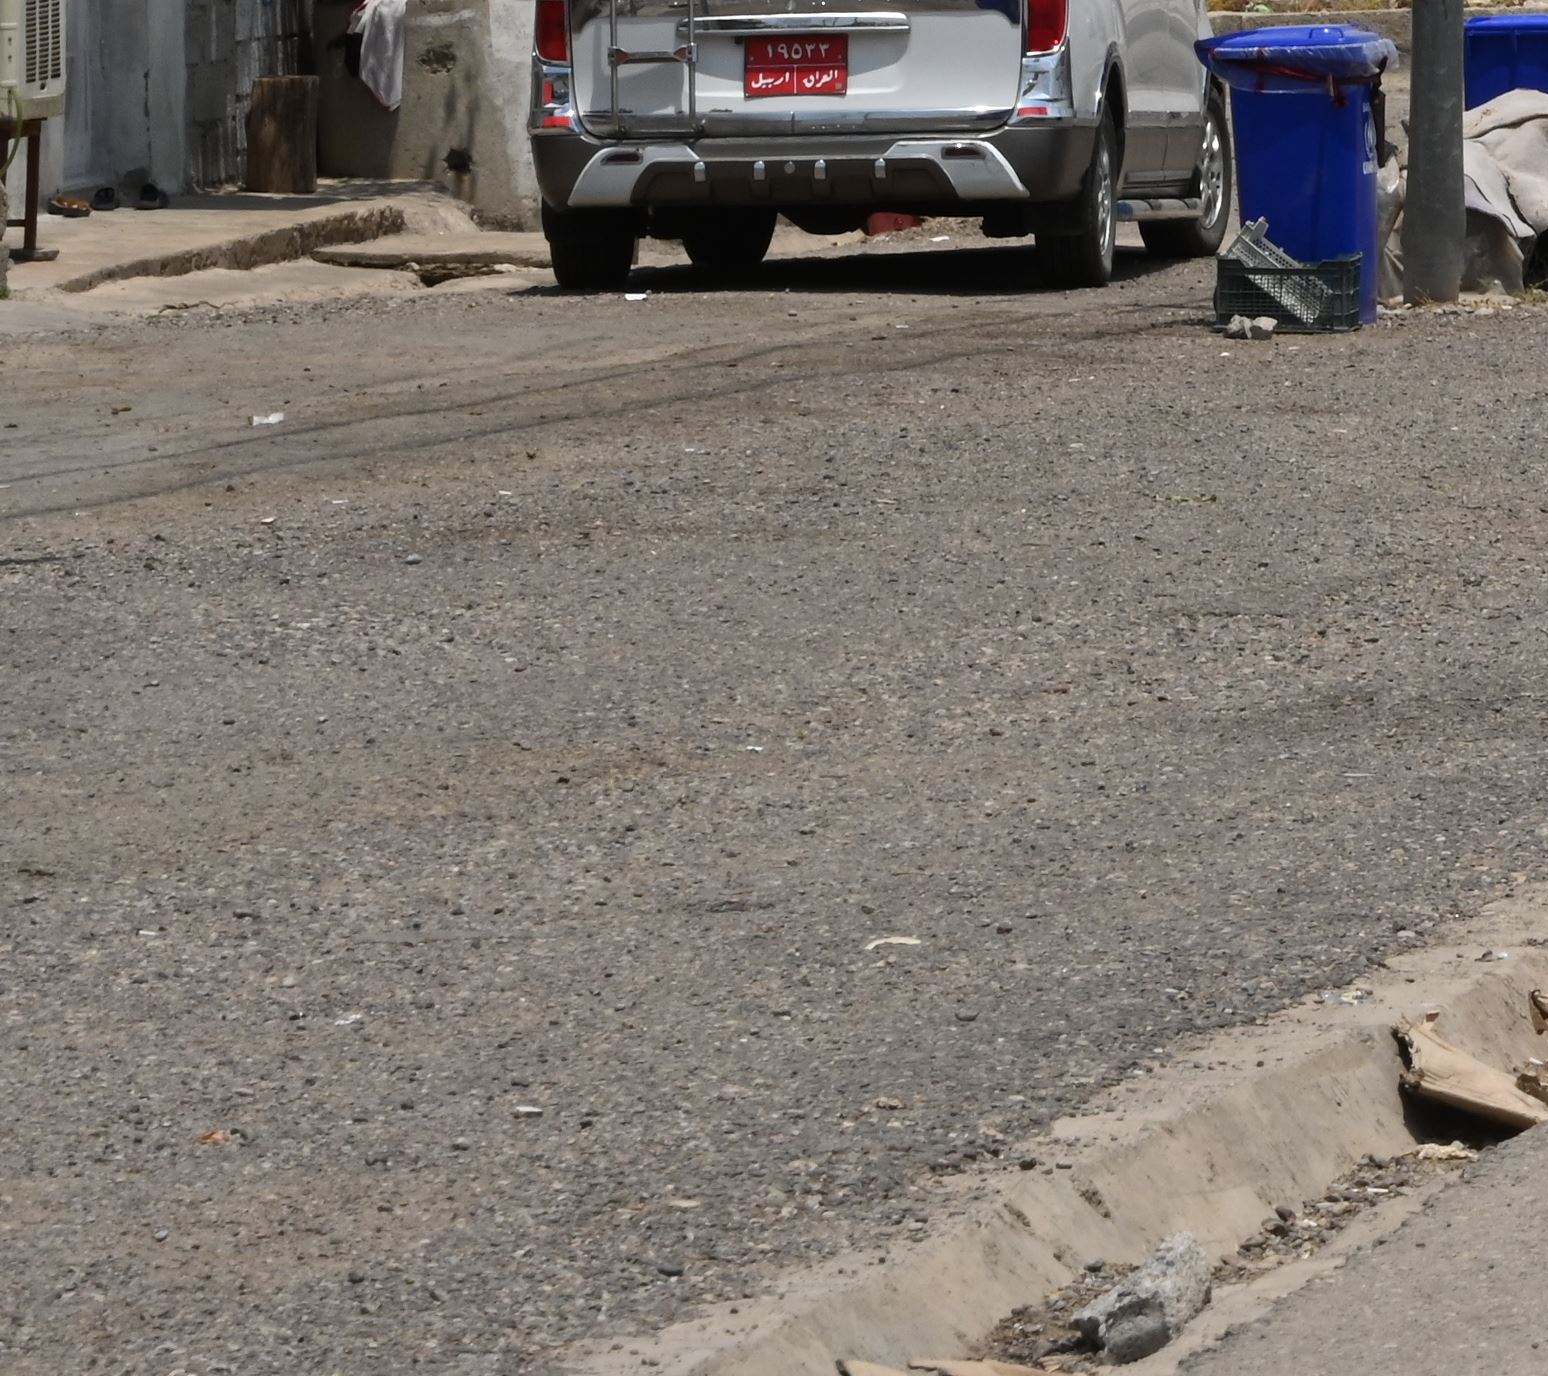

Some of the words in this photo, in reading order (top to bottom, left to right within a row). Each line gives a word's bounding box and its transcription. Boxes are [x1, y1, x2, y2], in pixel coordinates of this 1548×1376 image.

[767, 42, 830, 60] ١٩٥٣٣
[750, 71, 790, 89] اربيل
[802, 69, 839, 89] العراق
